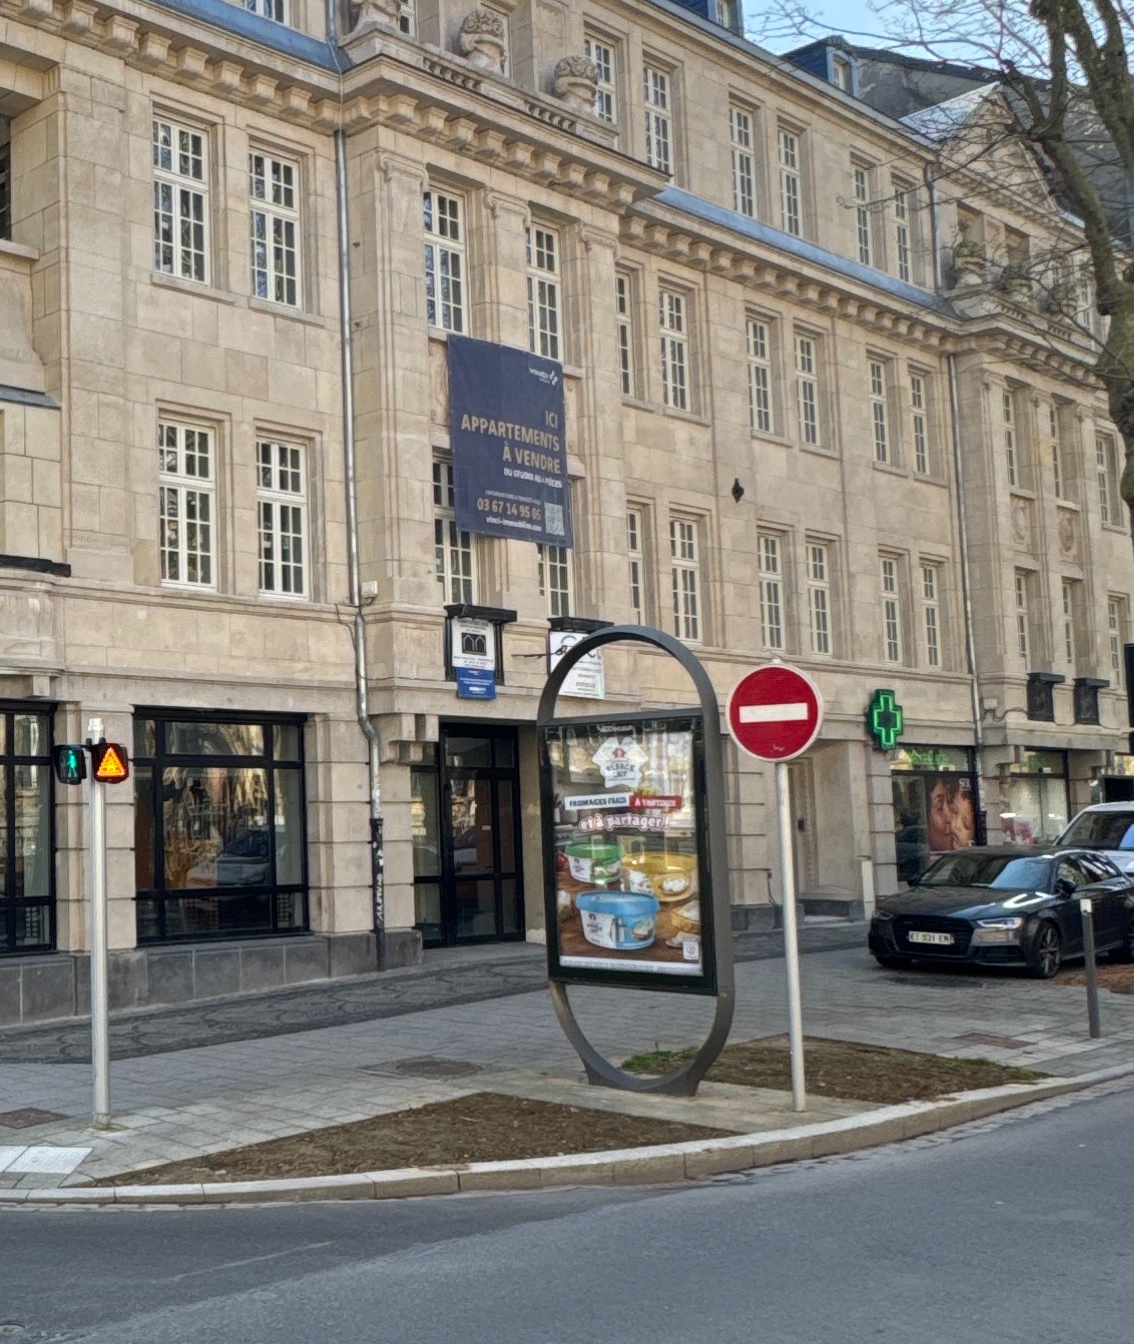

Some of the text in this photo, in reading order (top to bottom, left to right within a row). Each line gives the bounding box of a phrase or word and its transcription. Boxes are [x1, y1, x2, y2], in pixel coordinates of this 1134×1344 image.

[545, 410, 558, 429] ICI
[461, 414, 560, 452] APPARTEMENTS
[502, 440, 561, 474] À VENDRE
[476, 497, 490, 511] 03
[491, 500, 504, 514] 67
[506, 502, 518, 516] 14
[580, 817, 594, 830] et
[594, 813, 605, 828] à
[606, 813, 663, 829] partager
